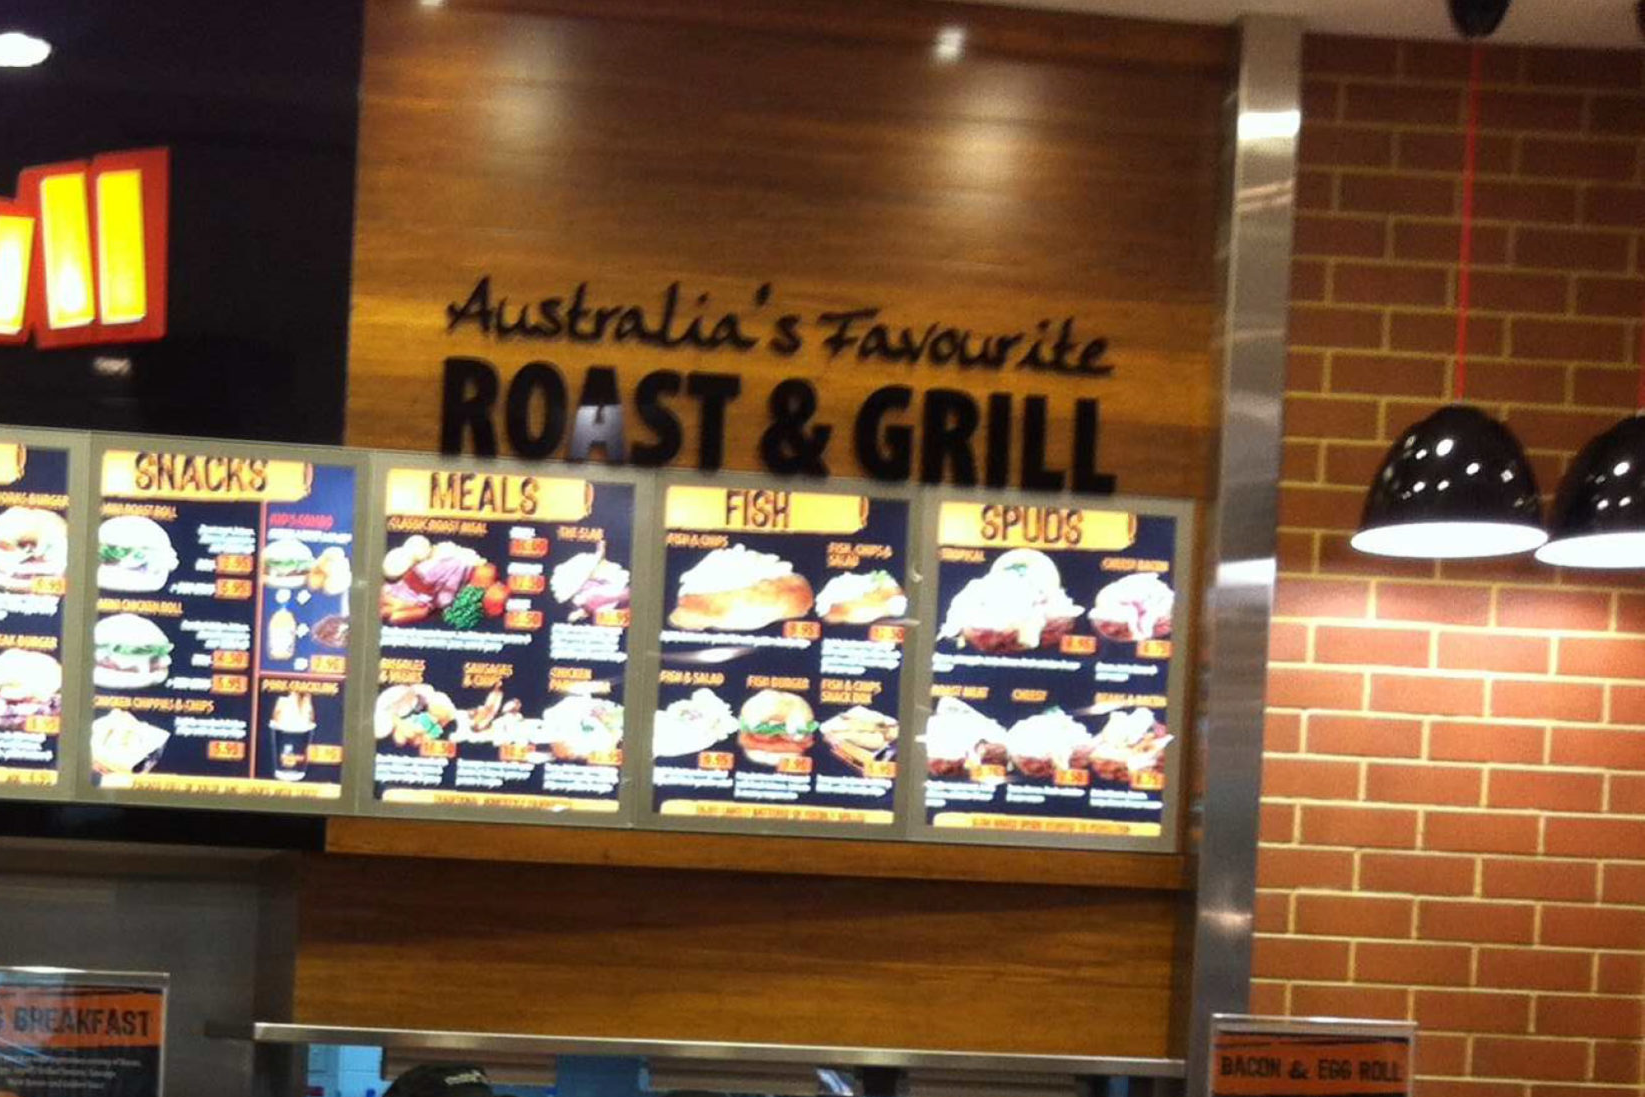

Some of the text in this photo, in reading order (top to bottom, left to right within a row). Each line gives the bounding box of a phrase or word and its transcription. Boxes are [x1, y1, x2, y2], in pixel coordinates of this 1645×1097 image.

[445, 276, 1116, 377] Australia's Favourite
[440, 356, 1118, 496] ROAST & GRILL
[135, 451, 269, 492] SNACKS
[430, 471, 539, 515] MEALS
[726, 489, 790, 528] FISH
[980, 504, 1084, 545] SPUDS
[13, 1005, 152, 1037] BREAKFAST
[1220, 1055, 1403, 1083] BACON & EGG ROLL
